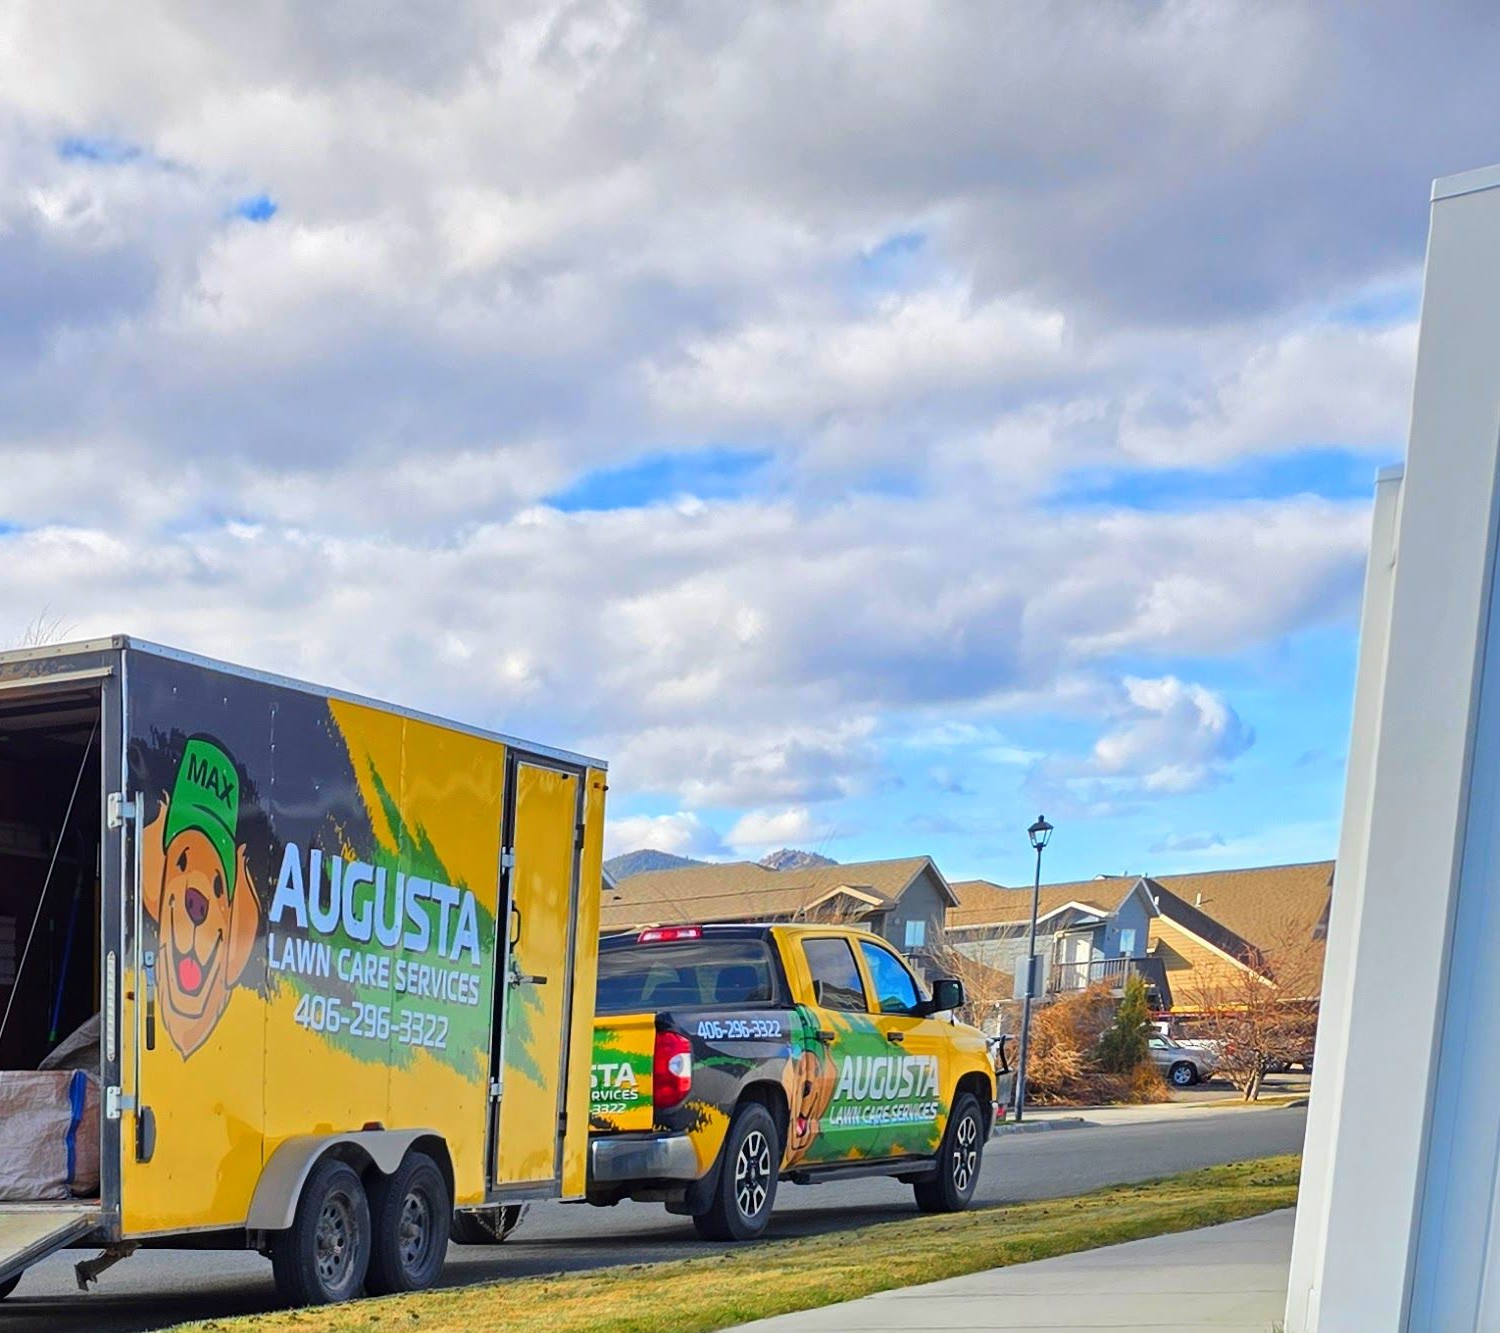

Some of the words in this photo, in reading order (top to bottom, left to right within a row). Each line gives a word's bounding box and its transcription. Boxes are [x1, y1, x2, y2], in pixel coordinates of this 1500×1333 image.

[187, 753, 234, 810] MAX
[268, 842, 481, 966] AUGUSTA
[268, 933, 331, 978] LAWN
[337, 949, 390, 989] CARE
[395, 959, 480, 1006] SERVICES
[294, 993, 449, 1049] 406-296-3322
[697, 1020, 782, 1040] 406-296-3322
[833, 1055, 940, 1100] AUGUSTA
[829, 1105, 860, 1125] LAWN
[862, 1104, 890, 1124] CARE
[891, 1102, 939, 1122] SERVICES
